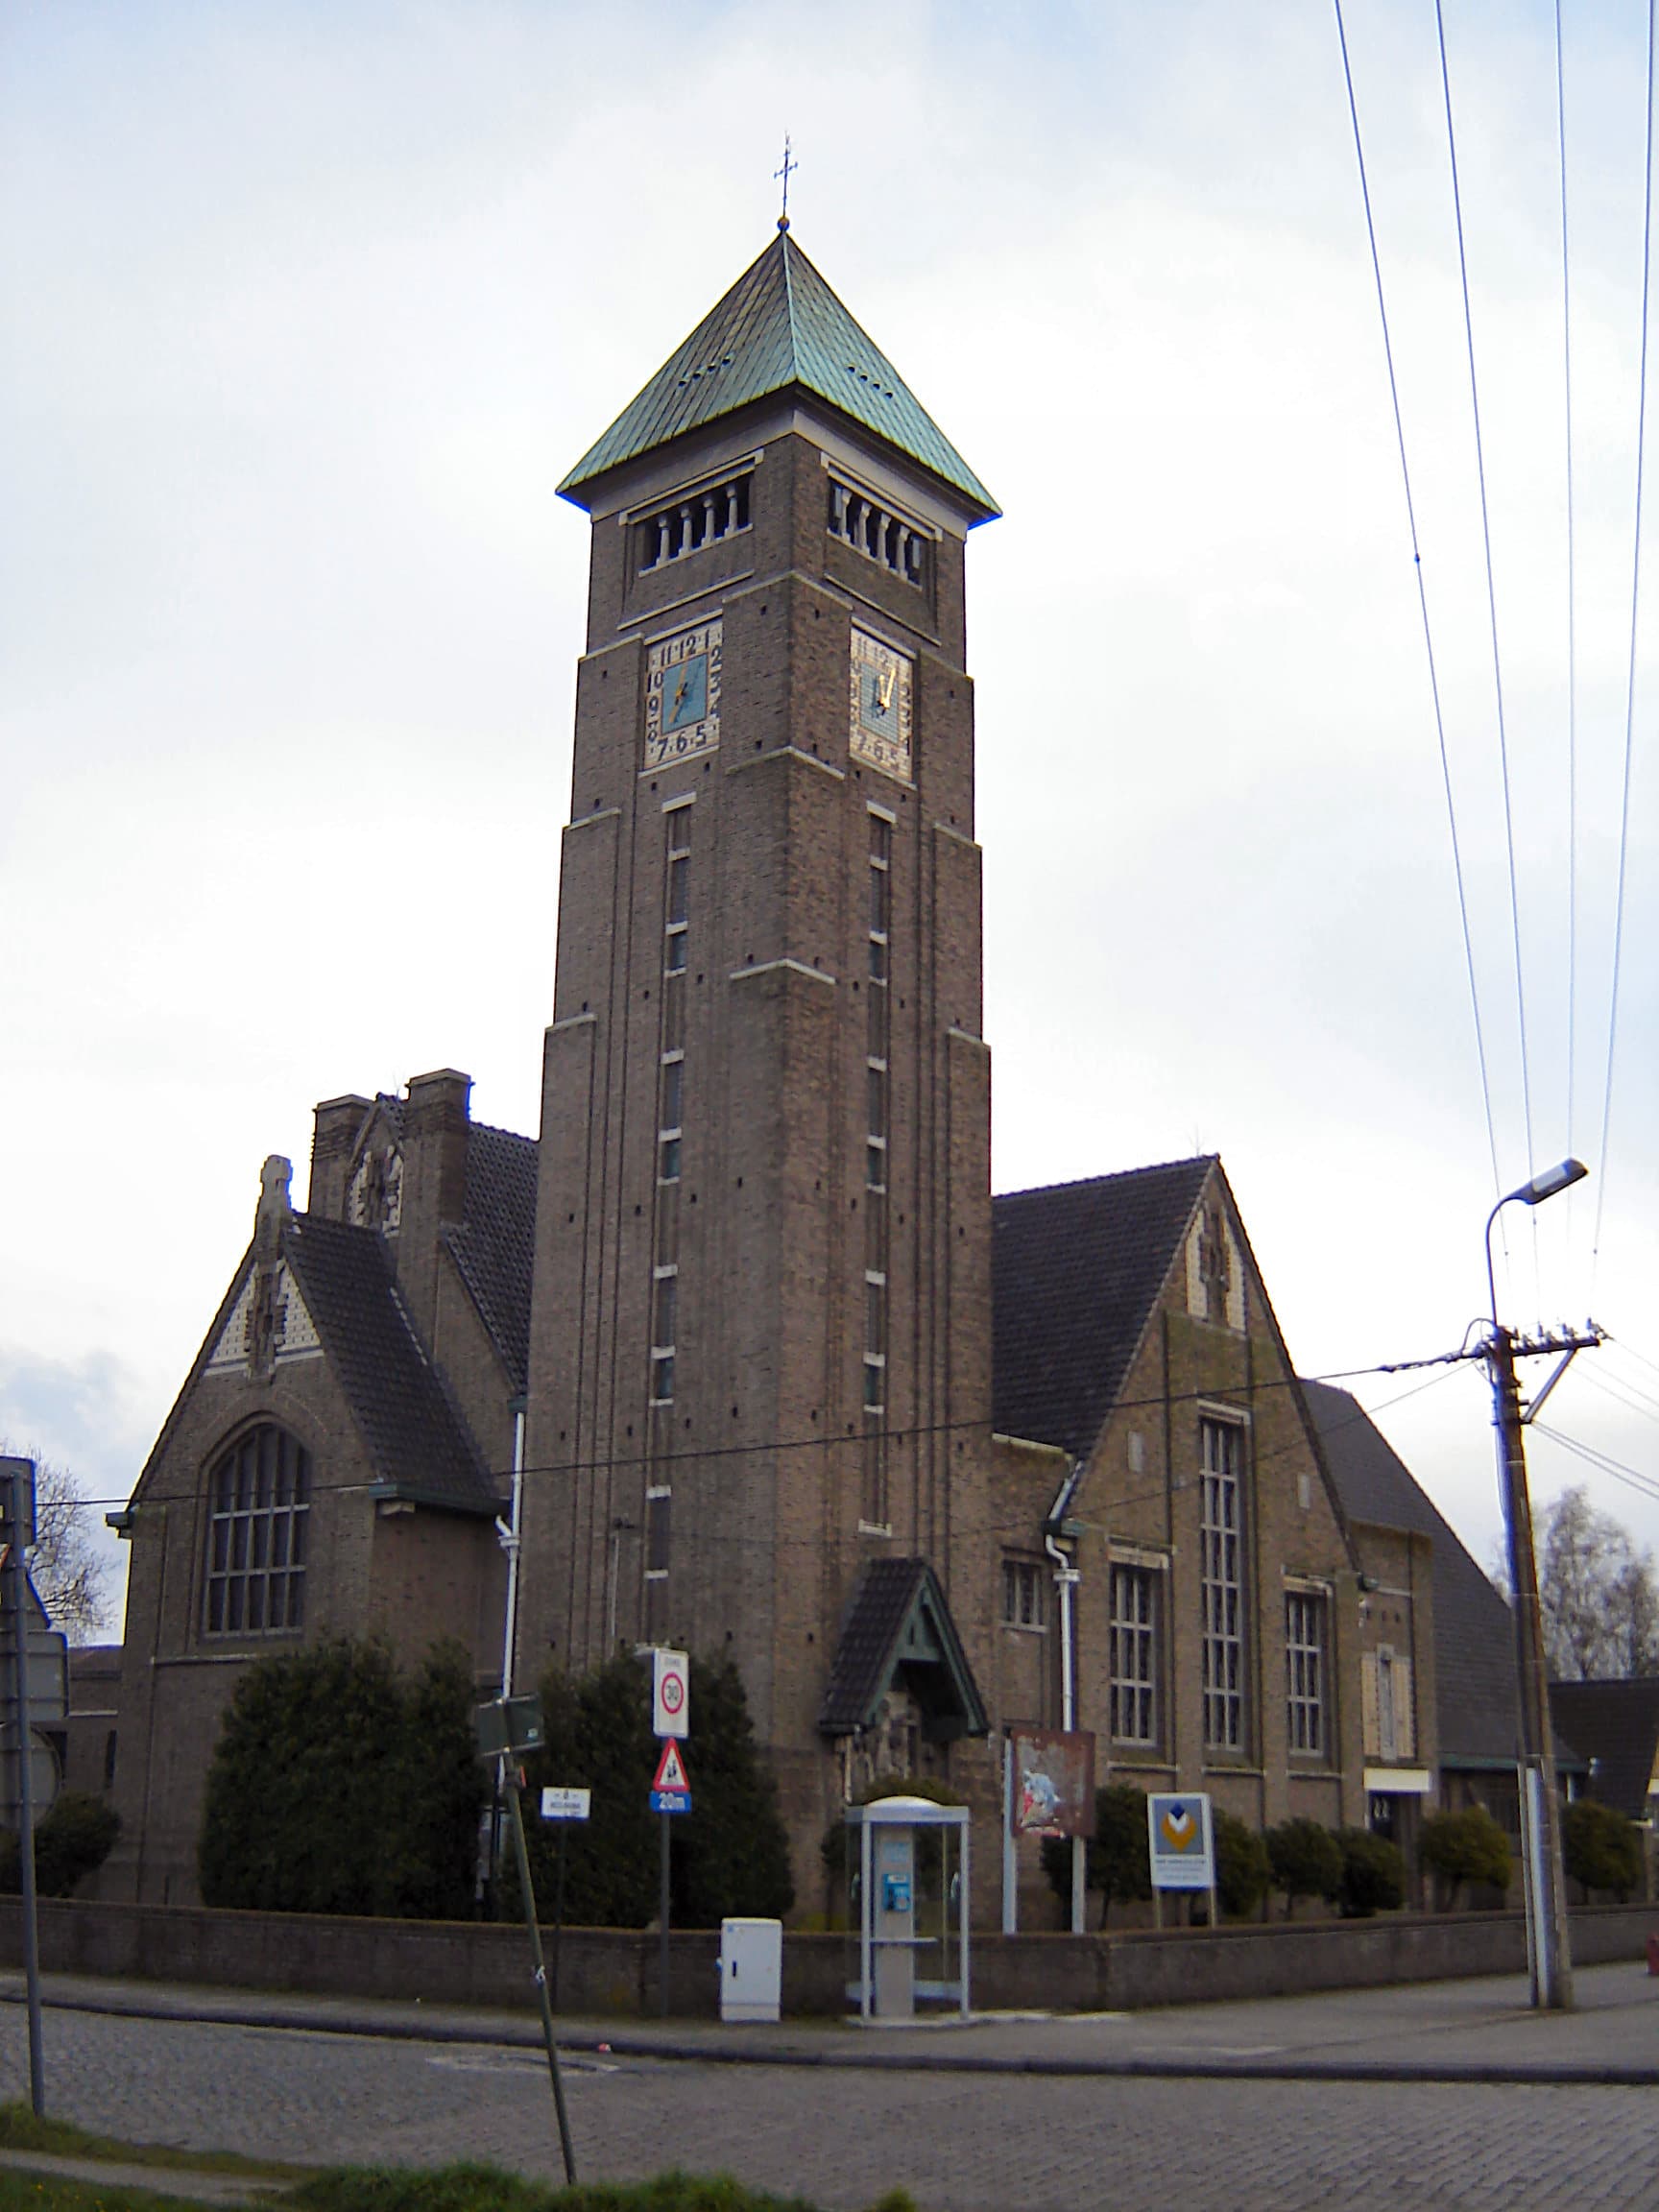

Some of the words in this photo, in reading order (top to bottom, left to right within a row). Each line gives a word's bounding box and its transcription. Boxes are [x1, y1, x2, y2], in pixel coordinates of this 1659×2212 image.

[680, 634, 696, 660] 12
[704, 629, 709, 649] 1
[661, 645, 672, 666] 11
[646, 672, 663, 693] 10
[648, 696, 659, 717] 9
[676, 731, 687, 753] 6
[695, 724, 707, 747] 5
[657, 737, 668, 761] 7
